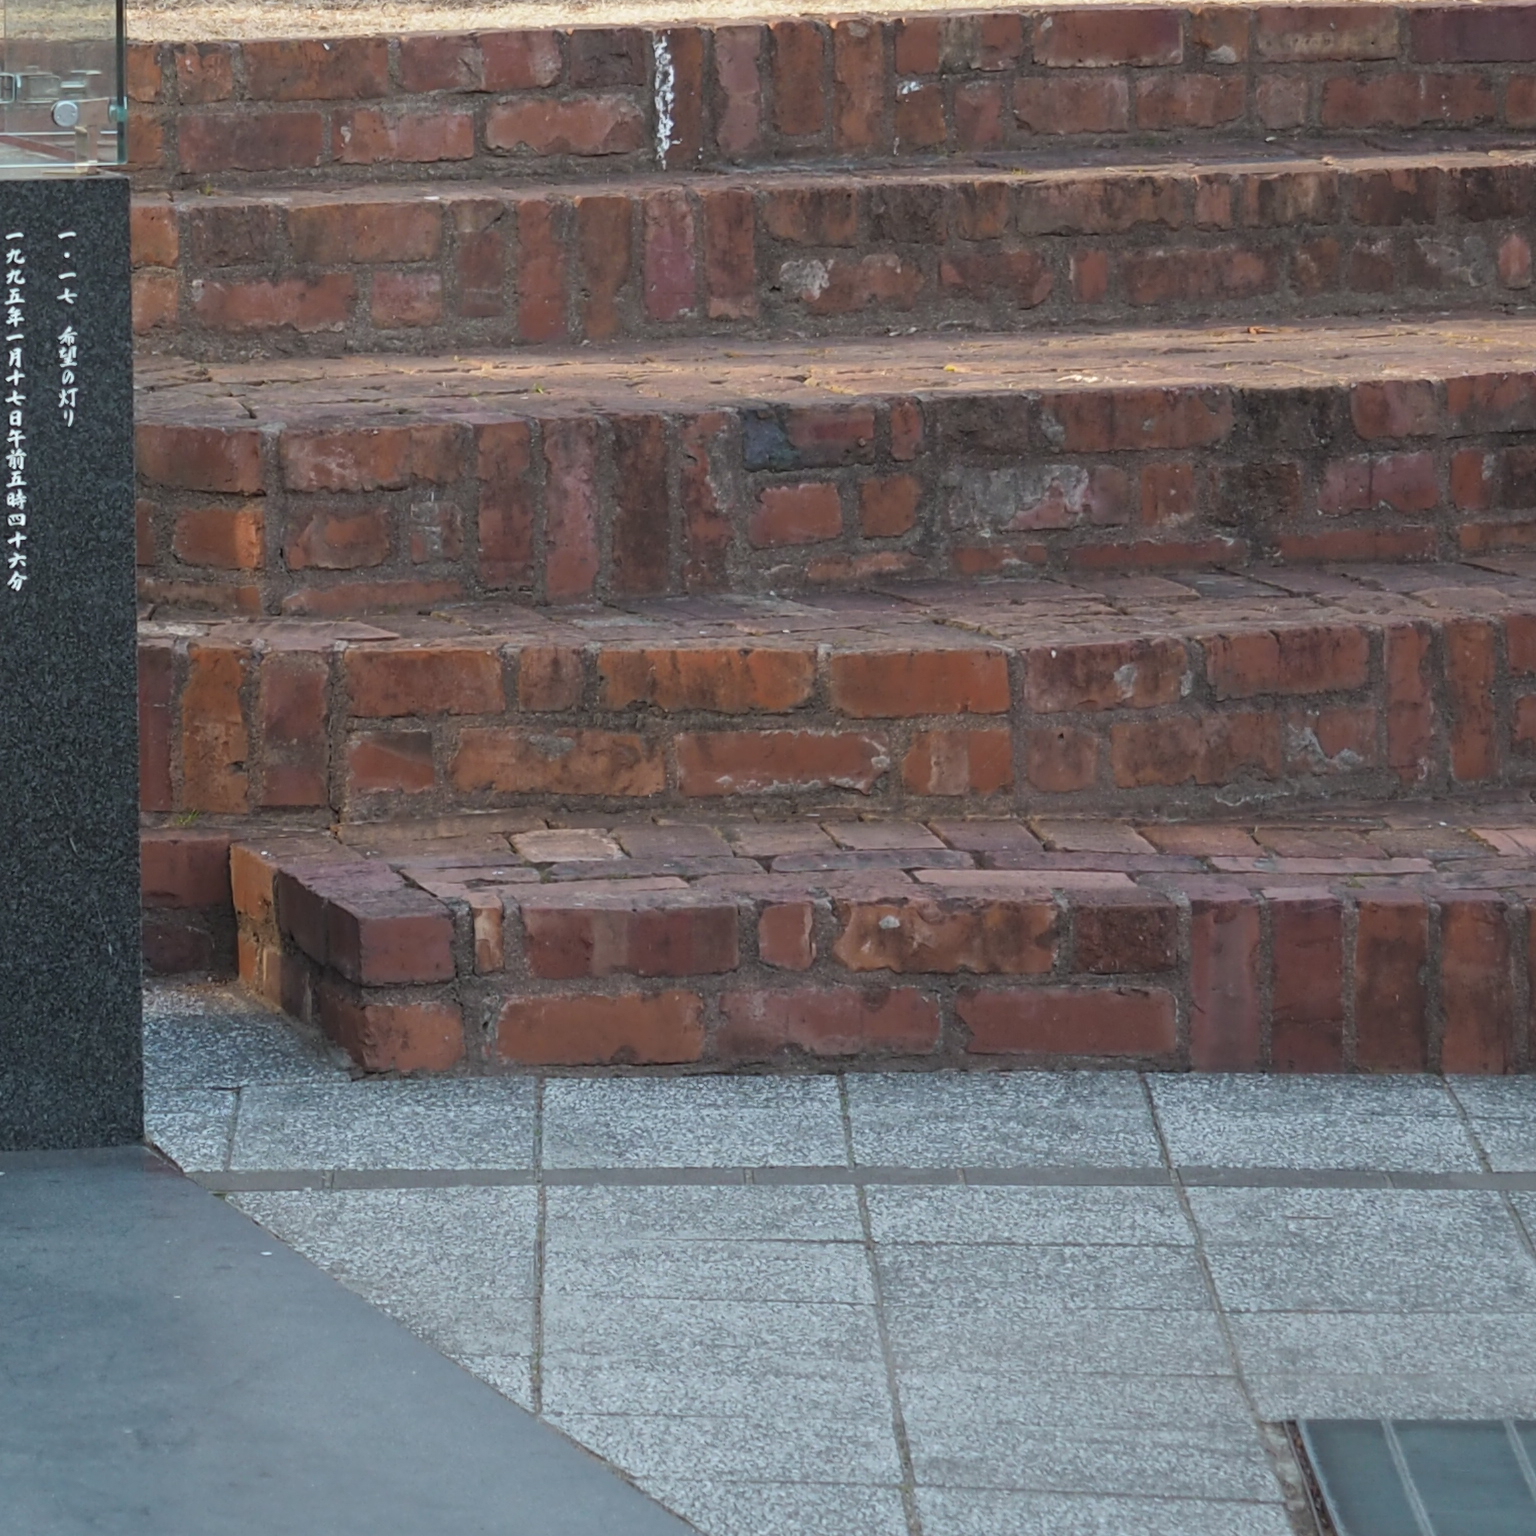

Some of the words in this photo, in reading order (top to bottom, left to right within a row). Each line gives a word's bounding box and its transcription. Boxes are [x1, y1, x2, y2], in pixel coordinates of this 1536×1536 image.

[4, 231, 28, 592] 一九九五年一月十七日午前五時四十六分
[57, 325, 79, 428] 希望の灯り
